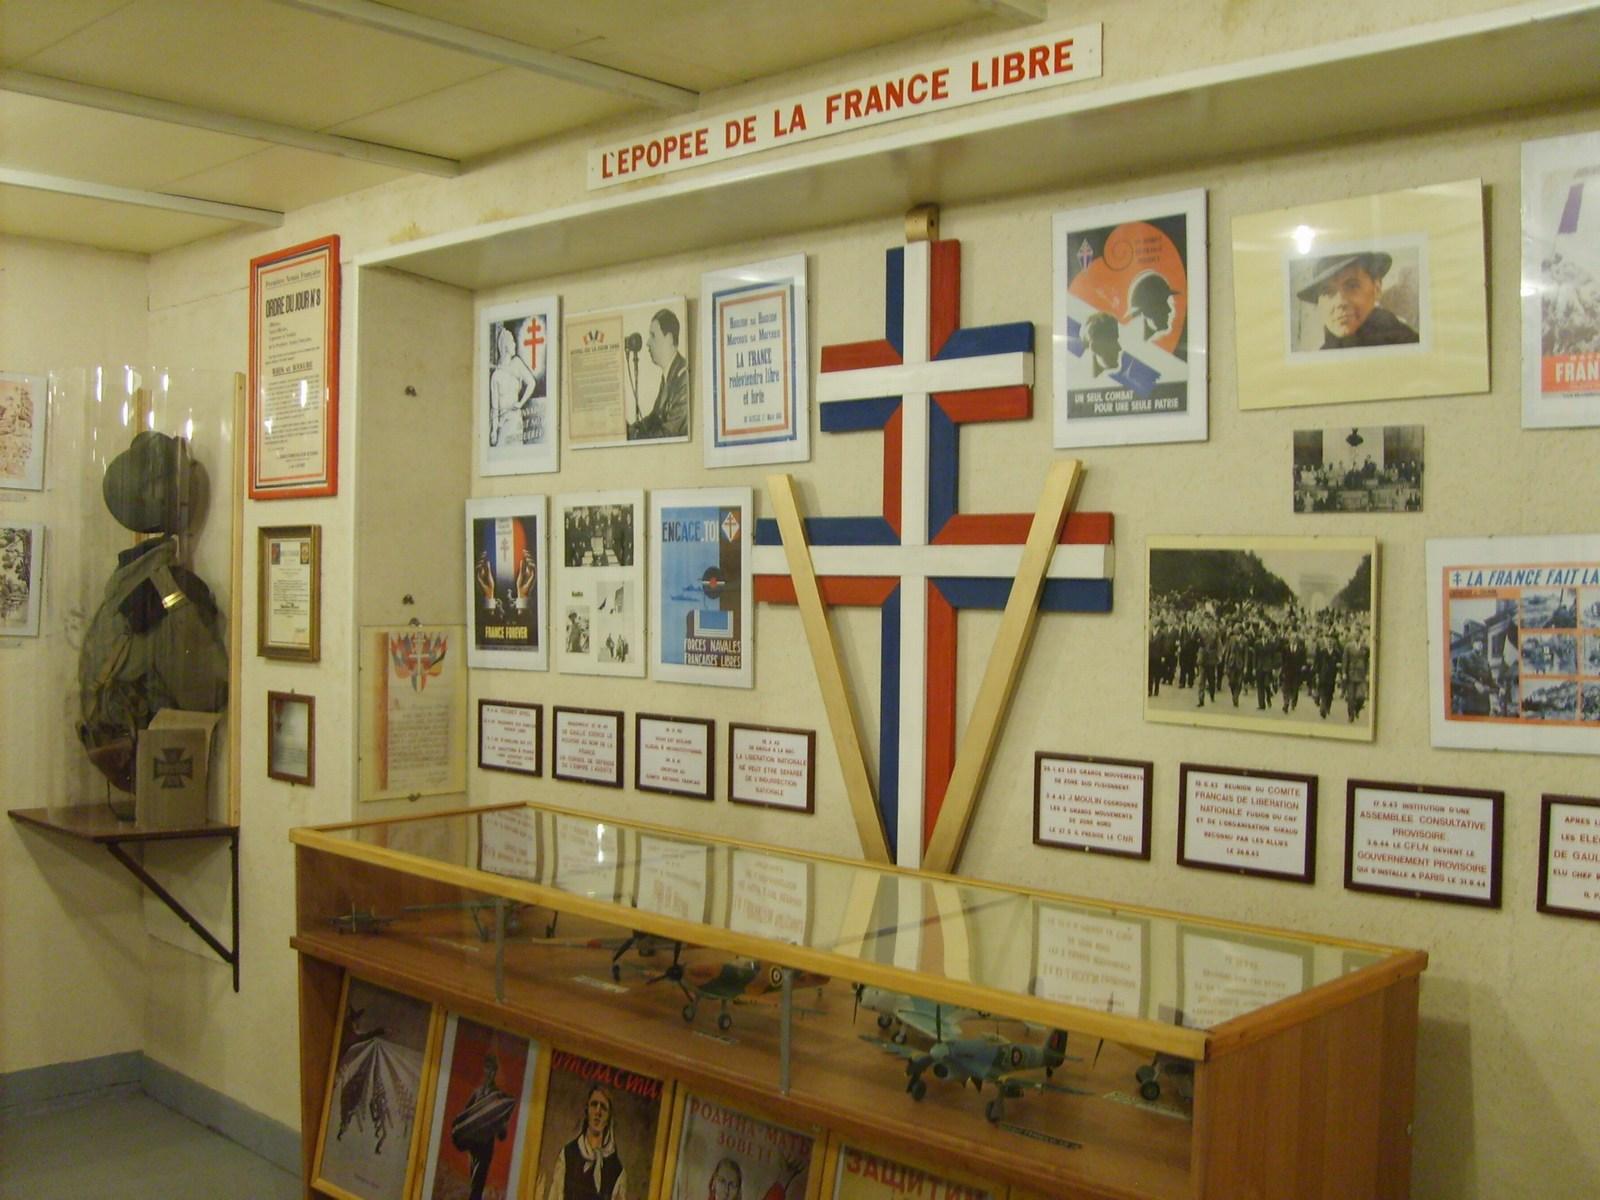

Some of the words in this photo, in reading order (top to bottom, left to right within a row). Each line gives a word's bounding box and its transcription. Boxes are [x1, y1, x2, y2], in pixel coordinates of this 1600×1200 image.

[725, 115, 757, 149] DE
[773, 103, 807, 138] LA
[825, 68, 950, 125] FRANCE
[971, 38, 1074, 93] LIBRE
[266, 295, 285, 318] ORDRE
[285, 293, 295, 314] DU
[295, 290, 310, 312] JOUR
[736, 352, 744, 369] LA
[748, 347, 772, 367] FRANCE
[765, 367, 780, 384] libre
[1074, 394, 1084, 403] UN
[1086, 392, 1103, 402] SEUL
[1105, 390, 1134, 401] COMBAT
[1094, 402, 1114, 414] POUR
[1115, 401, 1129, 412] UNE
[1131, 399, 1152, 410] SEULE
[1154, 398, 1179, 409] PATRIE
[1467, 570, 1483, 586] LA
[1487, 569, 1543, 586] FRANCE
[1546, 568, 1580, 585] FAIT
[1582, 568, 1600, 585] LA
[485, 626, 505, 639] FRANCE
[505, 626, 528, 640] FOREVER
[684, 637, 706, 652] FORCES
[710, 638, 741, 653] NAVALES
[720, 655, 741, 668] LIBRES
[744, 753, 775, 763] LIBERATION
[777, 758, 806, 766] NATIONALE
[1104, 772, 1144, 781] MOUVEMENTS
[755, 787, 783, 796] NATIONALE
[1224, 783, 1251, 791] REUNION
[1268, 785, 1301, 797] COMITE
[1074, 794, 1102, 805] MOULIN
[1195, 790, 1234, 802] FRANCAIS
[1236, 796, 1248, 804] DE
[1251, 796, 1299, 811] LIBERATION
[1200, 803, 1242, 817] NATIONALE
[1246, 811, 1270, 819] FUSION
[1402, 802, 1446, 812] INSTITUTION
[1095, 809, 1133, 820] MOUVEMENTS
[1359, 810, 1413, 823] ASSEMBLEE
[1419, 815, 1487, 831] CONSULTATIVE
[1564, 816, 1591, 825] APRES
[1117, 832, 1134, 844] CNR
[1273, 826, 1298, 836] GIRAUD
[1392, 827, 1446, 841] PROVISOIRE
[1560, 832, 1575, 841] LES
[1204, 831, 1234, 840] RECONNU
[1252, 836, 1264, 844] LES
[1266, 838, 1289, 847] ALLIES
[1226, 847, 1234, 855] LE
[1404, 839, 1429, 852] CFLN
[1433, 846, 1463, 856] DEVIENT
[1466, 849, 1475, 857] LE
[1553, 849, 1568, 859] DE
[1357, 850, 1429, 867] GOUVERNEMENT
[1433, 859, 1487, 874] PROVISOIRE
[1357, 865, 1368, 873] QUI
[1419, 871, 1445, 882] PARIS
[1553, 868, 1568, 877] ELU
[1572, 870, 1592, 880] CHEF
